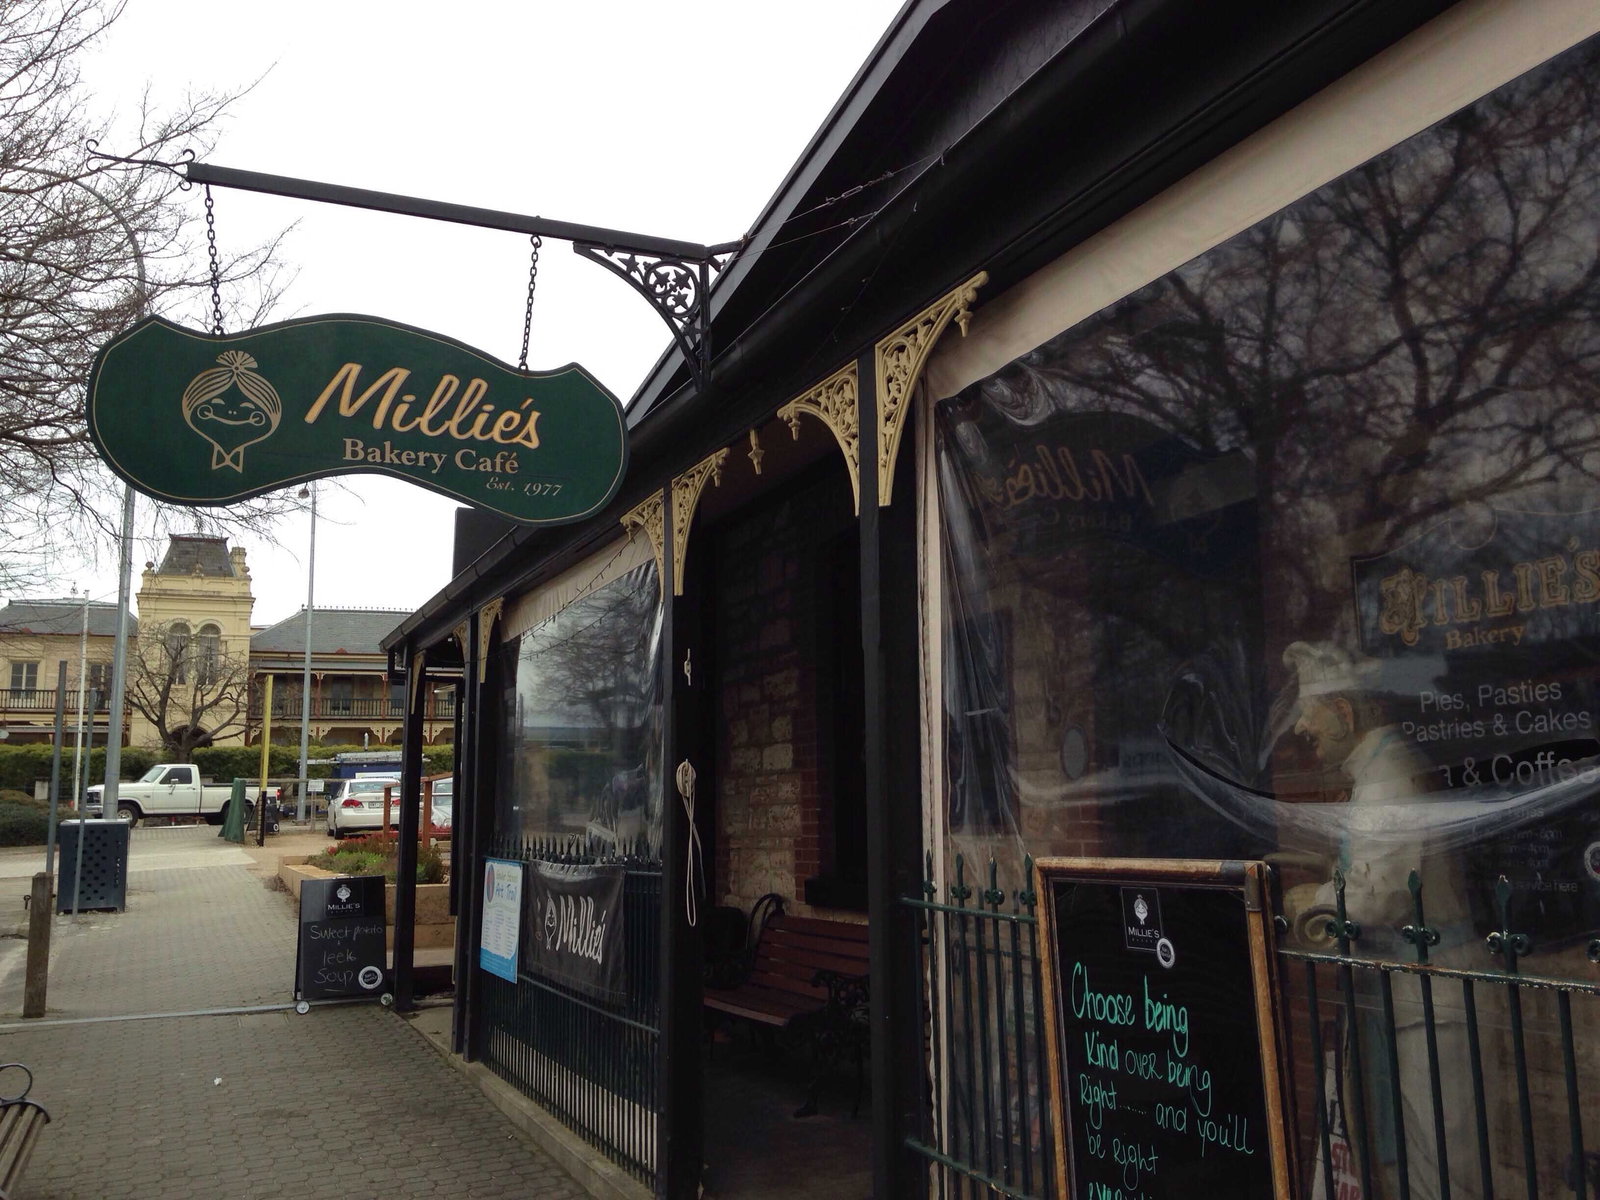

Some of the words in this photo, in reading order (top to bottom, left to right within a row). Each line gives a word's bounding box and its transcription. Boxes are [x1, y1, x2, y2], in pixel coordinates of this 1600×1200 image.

[304, 362, 541, 449] Millie's
[343, 438, 447, 474] Bakery
[455, 449, 519, 474] Café
[486, 476, 515, 491] Est.
[523, 483, 563, 497] 1977
[1445, 625, 1527, 650] Bakery
[1419, 690, 1471, 713] Pies,
[1478, 680, 1562, 707] Pasties
[1402, 717, 1486, 743] Pastries
[1493, 713, 1510, 736] &
[1515, 708, 1592, 735] Cakes
[1462, 756, 1482, 787] &
[1128, 926, 1160, 940] MILLIE'S
[1071, 962, 1136, 1026] Choose
[1144, 975, 1188, 1058] being
[1167, 1049, 1212, 1117] being
[1086, 1123, 1106, 1159] be
[1155, 1103, 1187, 1133] and
[1197, 1113, 1254, 1157] you'll
